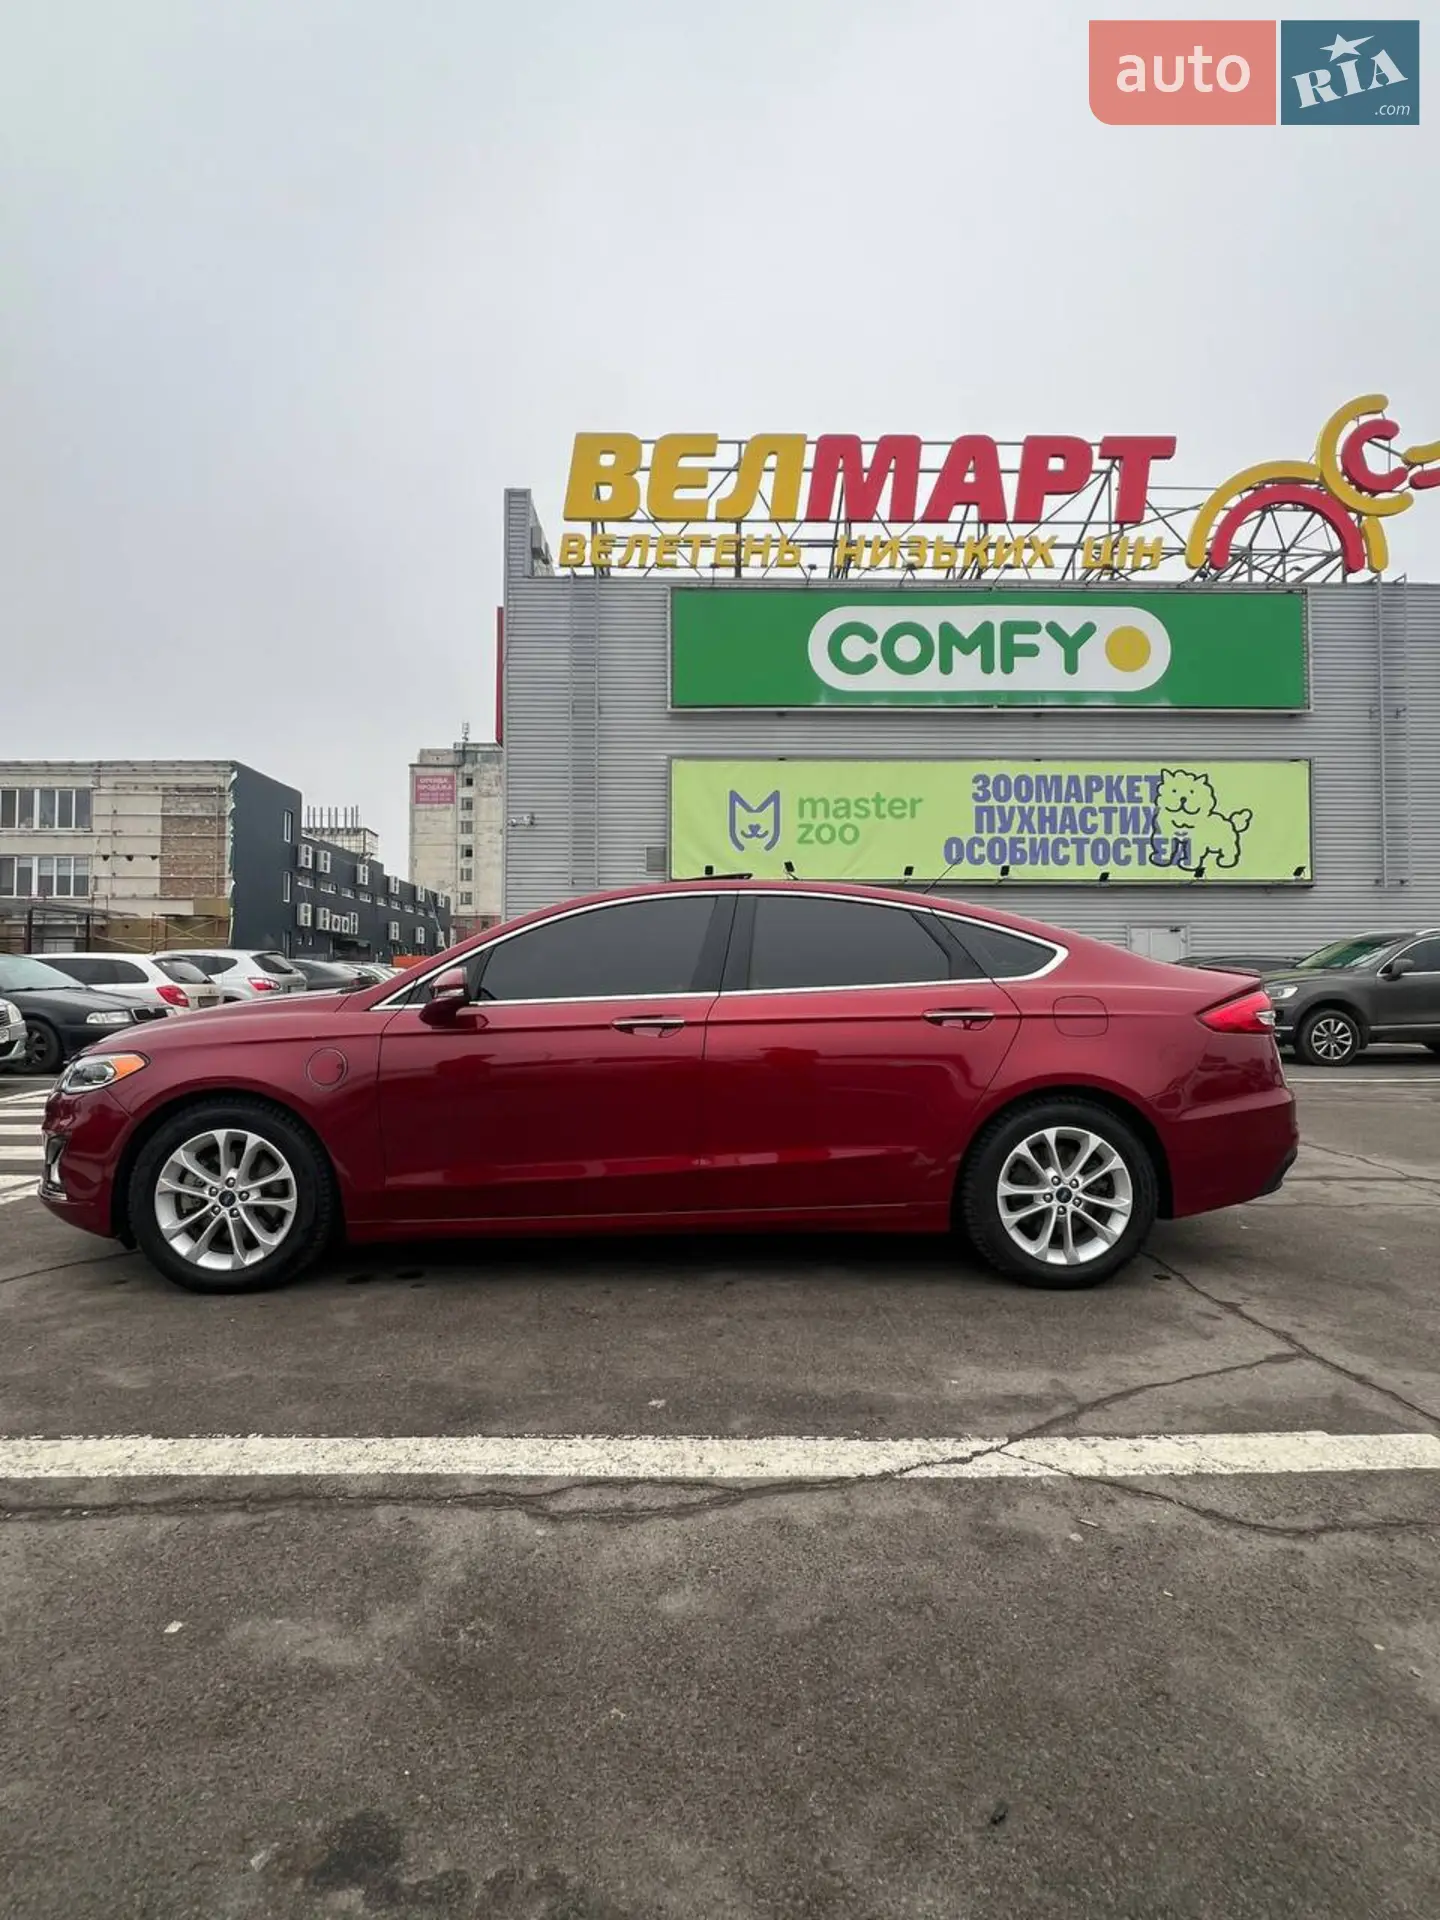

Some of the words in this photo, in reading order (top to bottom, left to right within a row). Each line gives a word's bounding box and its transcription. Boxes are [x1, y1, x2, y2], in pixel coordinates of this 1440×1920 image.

[563, 432, 1177, 524] ВЕЛМАРТ
[559, 532, 802, 568] ВЕЛЕТЕНЬ
[835, 533, 1058, 569] НИЗЬКИХ
[1081, 535, 1164, 573] ЦІН
[827, 620, 1097, 676] COMFY
[972, 774, 1162, 804] ЗООМАРКЕТ
[798, 791, 924, 820] master
[974, 805, 1163, 835] ПУХНАСТИХ
[796, 822, 860, 845] zoo
